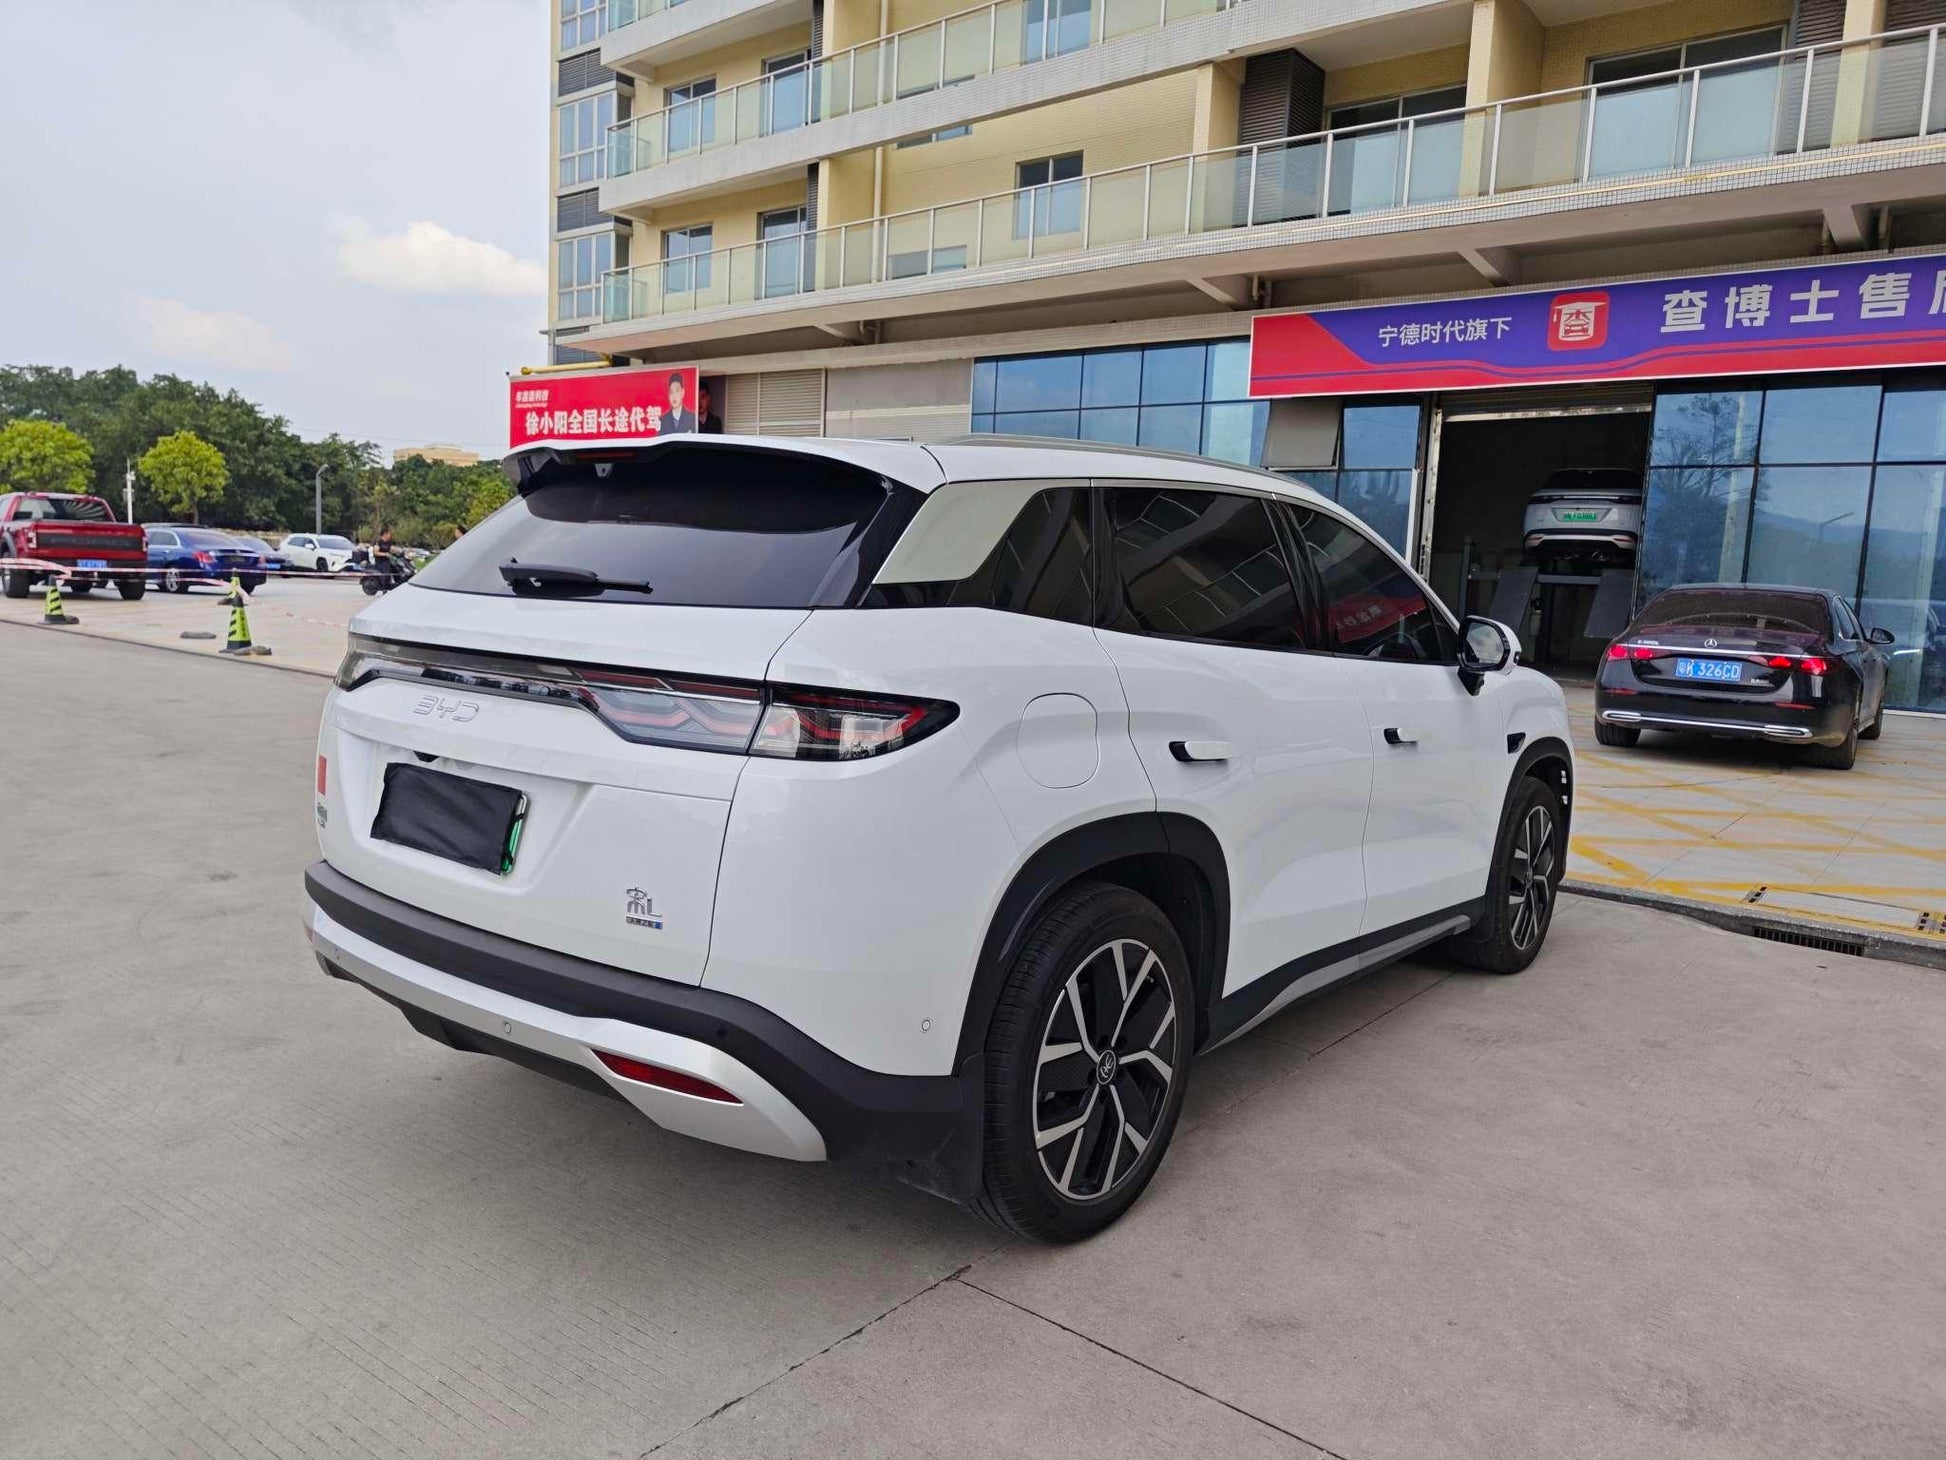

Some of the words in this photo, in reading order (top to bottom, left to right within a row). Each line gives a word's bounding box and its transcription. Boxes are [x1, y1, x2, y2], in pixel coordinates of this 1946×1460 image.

[1660, 269, 1946, 333] 查博士售
[1378, 316, 1512, 347] 宁德时代旗下
[525, 405, 662, 437] 徐小阳全国长途代驾
[413, 694, 479, 722] BYD
